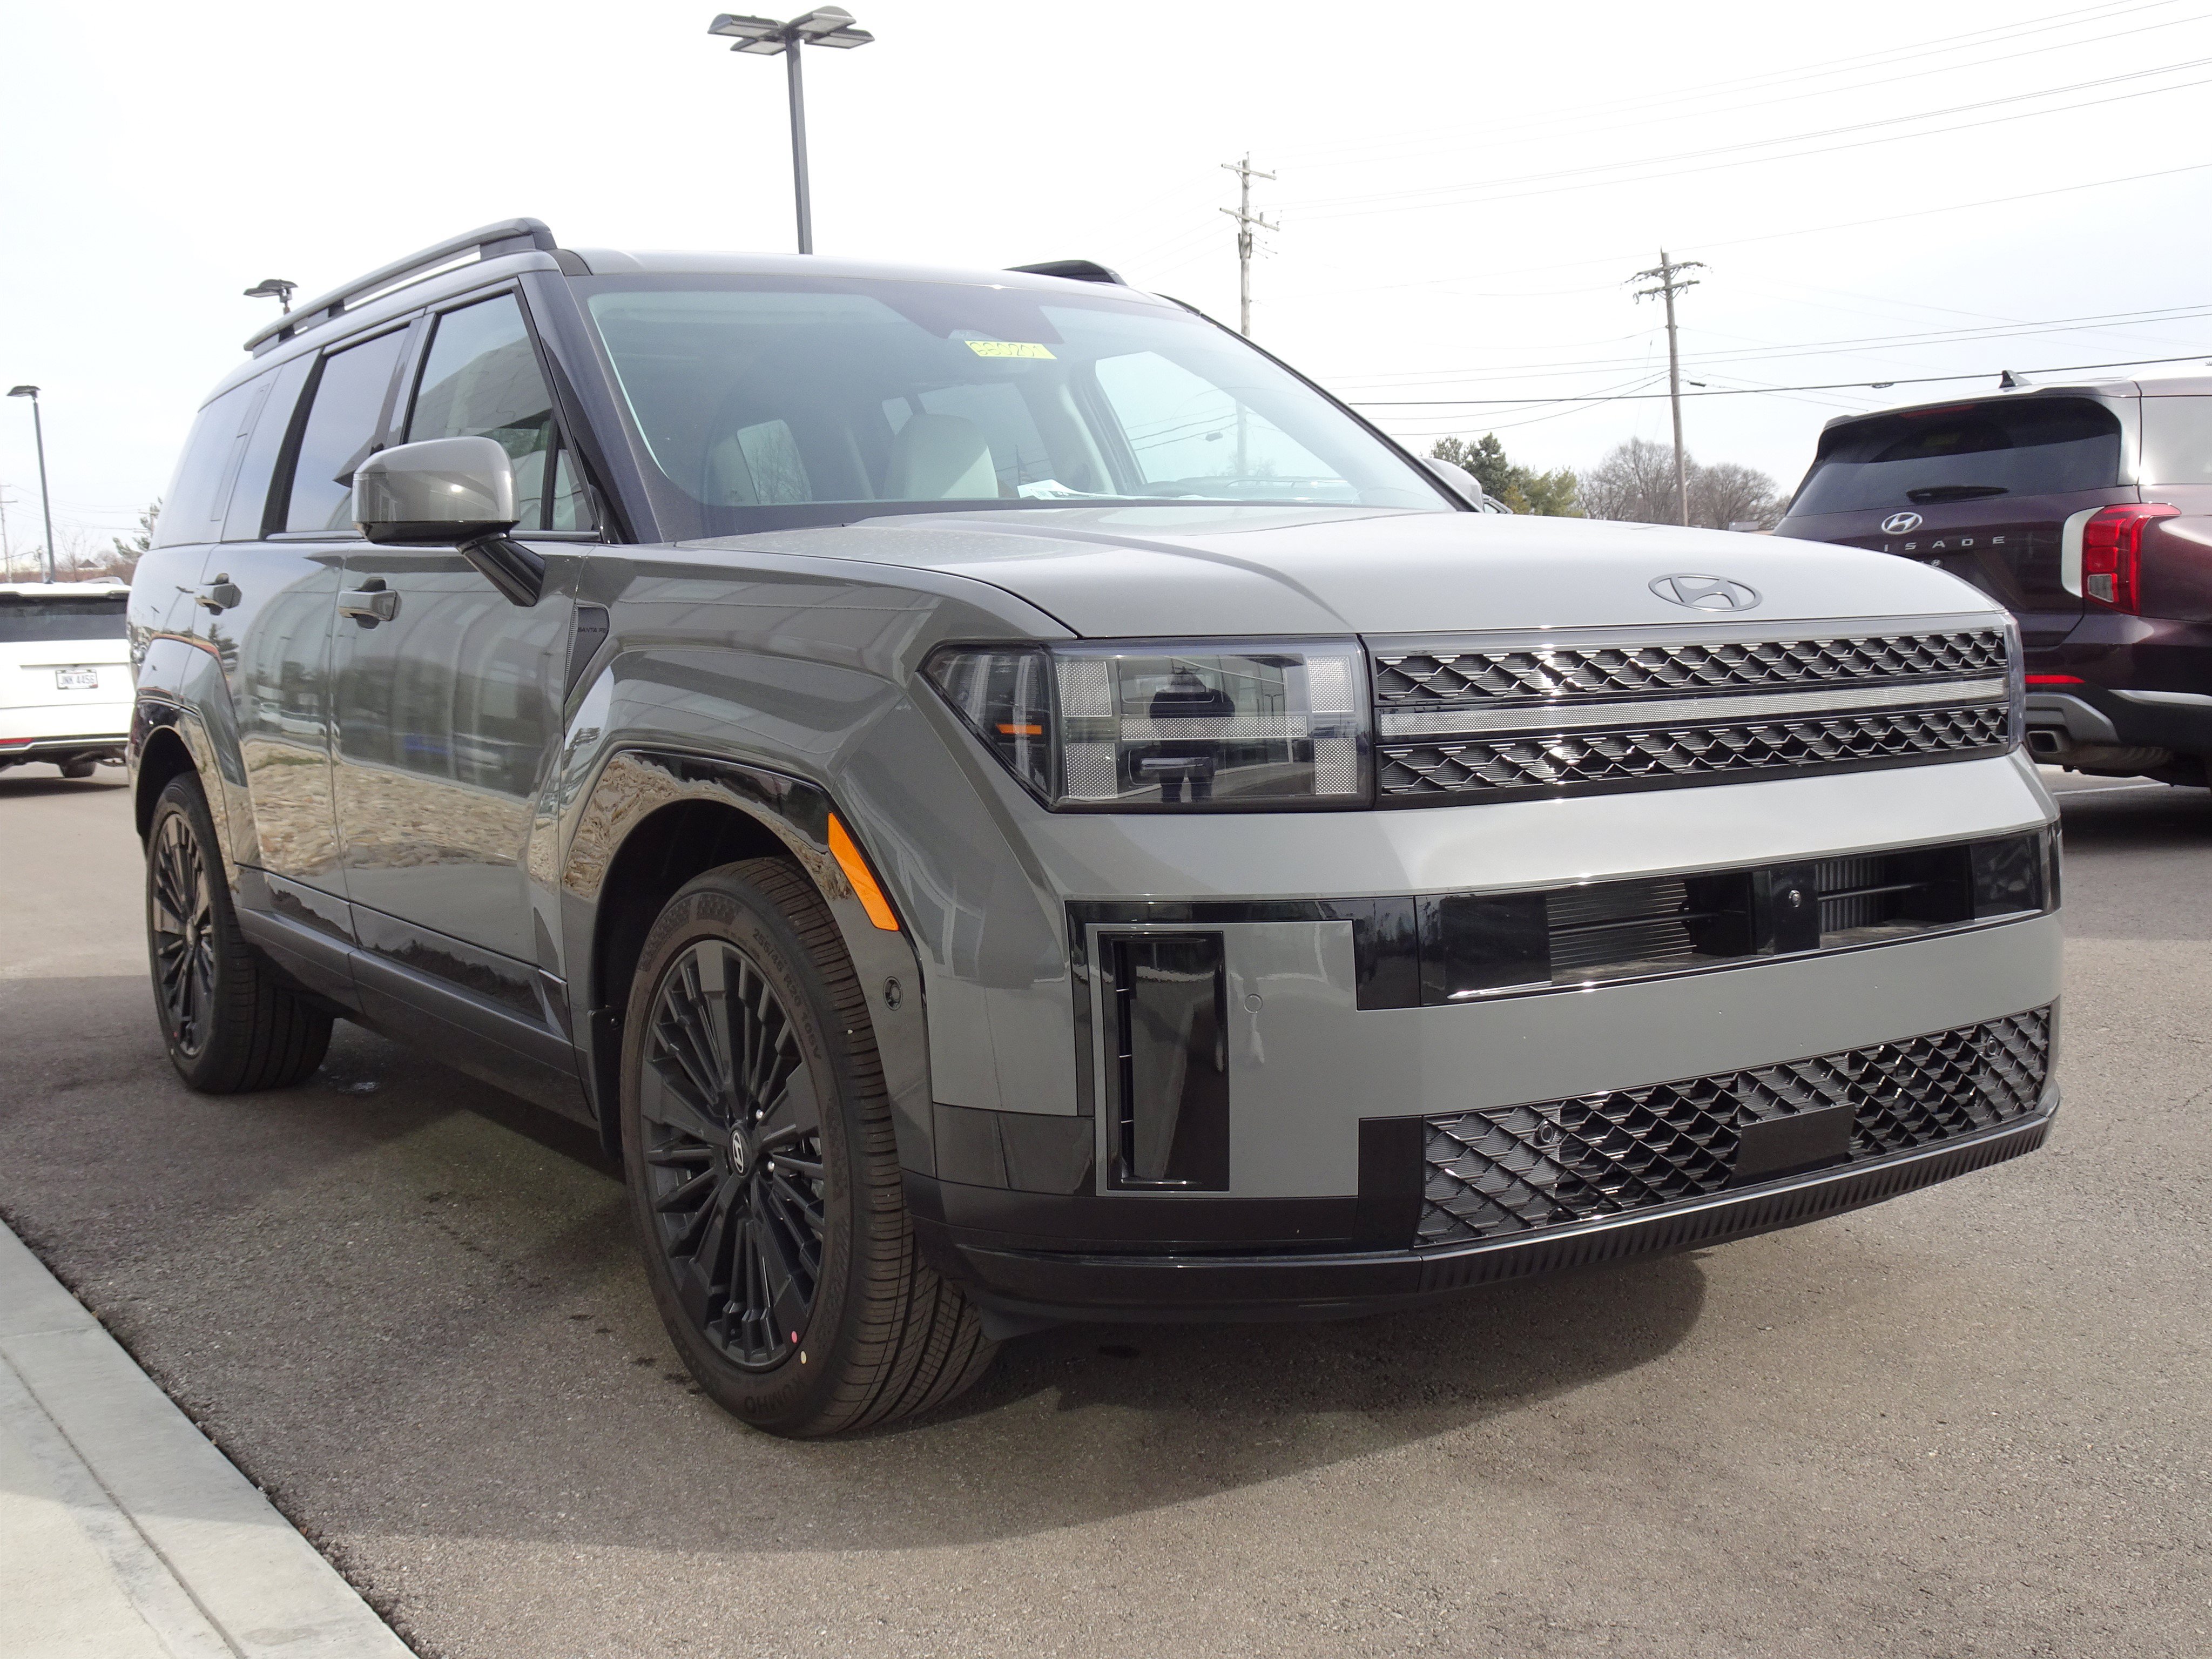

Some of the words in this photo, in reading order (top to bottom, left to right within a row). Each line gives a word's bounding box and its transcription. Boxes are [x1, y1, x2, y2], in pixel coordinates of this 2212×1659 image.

[1884, 536, 2005, 552] ISADE
[753, 928, 784, 971] 255/45
[784, 974, 801, 1007] R20
